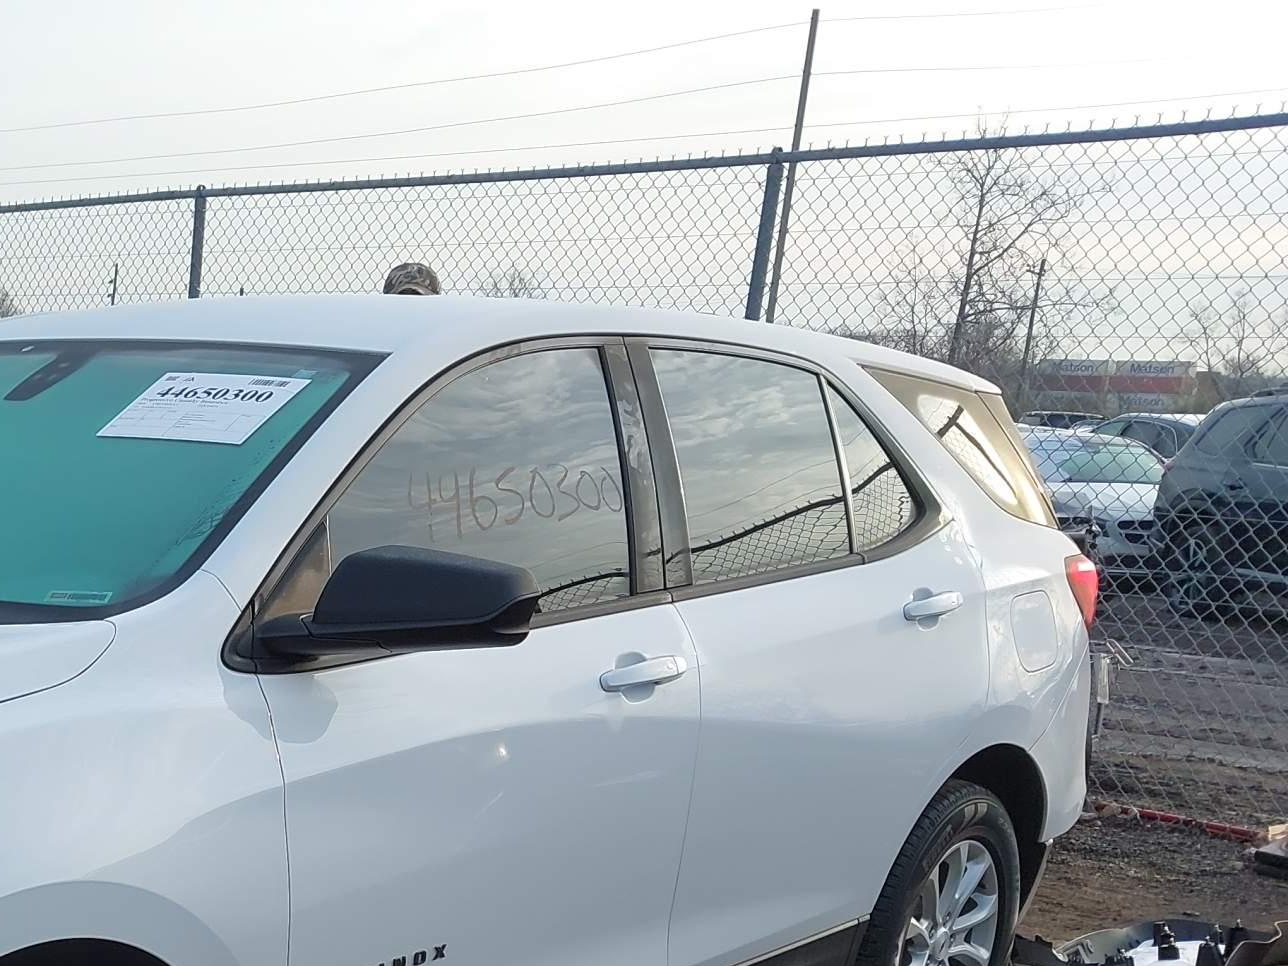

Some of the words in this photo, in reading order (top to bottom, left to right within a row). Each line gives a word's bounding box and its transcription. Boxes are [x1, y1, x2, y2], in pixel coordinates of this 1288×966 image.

[1129, 362, 1176, 375] Matson
[155, 384, 274, 404] 44650300
[408, 463, 623, 542] 44650300
